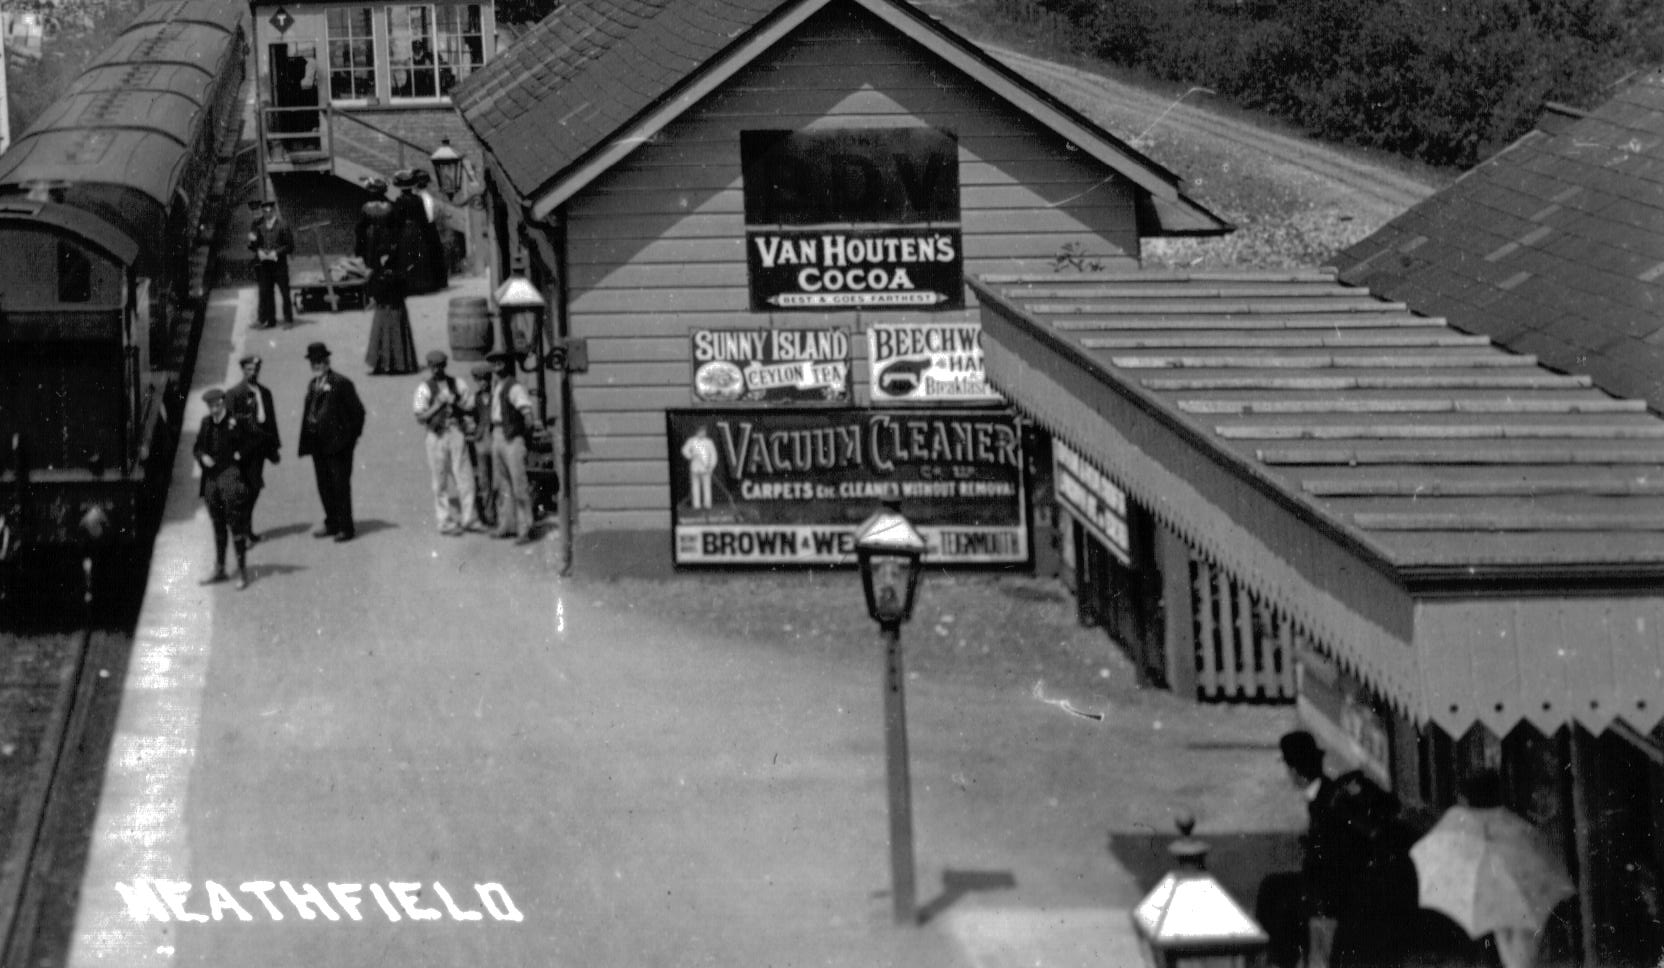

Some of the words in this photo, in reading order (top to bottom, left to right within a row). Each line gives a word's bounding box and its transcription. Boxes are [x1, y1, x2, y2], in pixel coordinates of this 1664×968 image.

[754, 236, 817, 268] VAN
[821, 234, 955, 267] HOUTEN'S
[797, 267, 915, 292] COCOA
[782, 295, 812, 305] BEST
[818, 295, 826, 304] &
[833, 294, 865, 304] GOES
[870, 293, 931, 303] FARTHEST
[695, 330, 768, 361] SUNNY
[771, 329, 848, 361] ISLAND
[748, 366, 804, 386] CEYLON
[814, 365, 843, 384] TEA
[716, 420, 862, 479] VACUUM
[741, 479, 814, 500] CARPETS
[702, 531, 797, 556] BROWN
